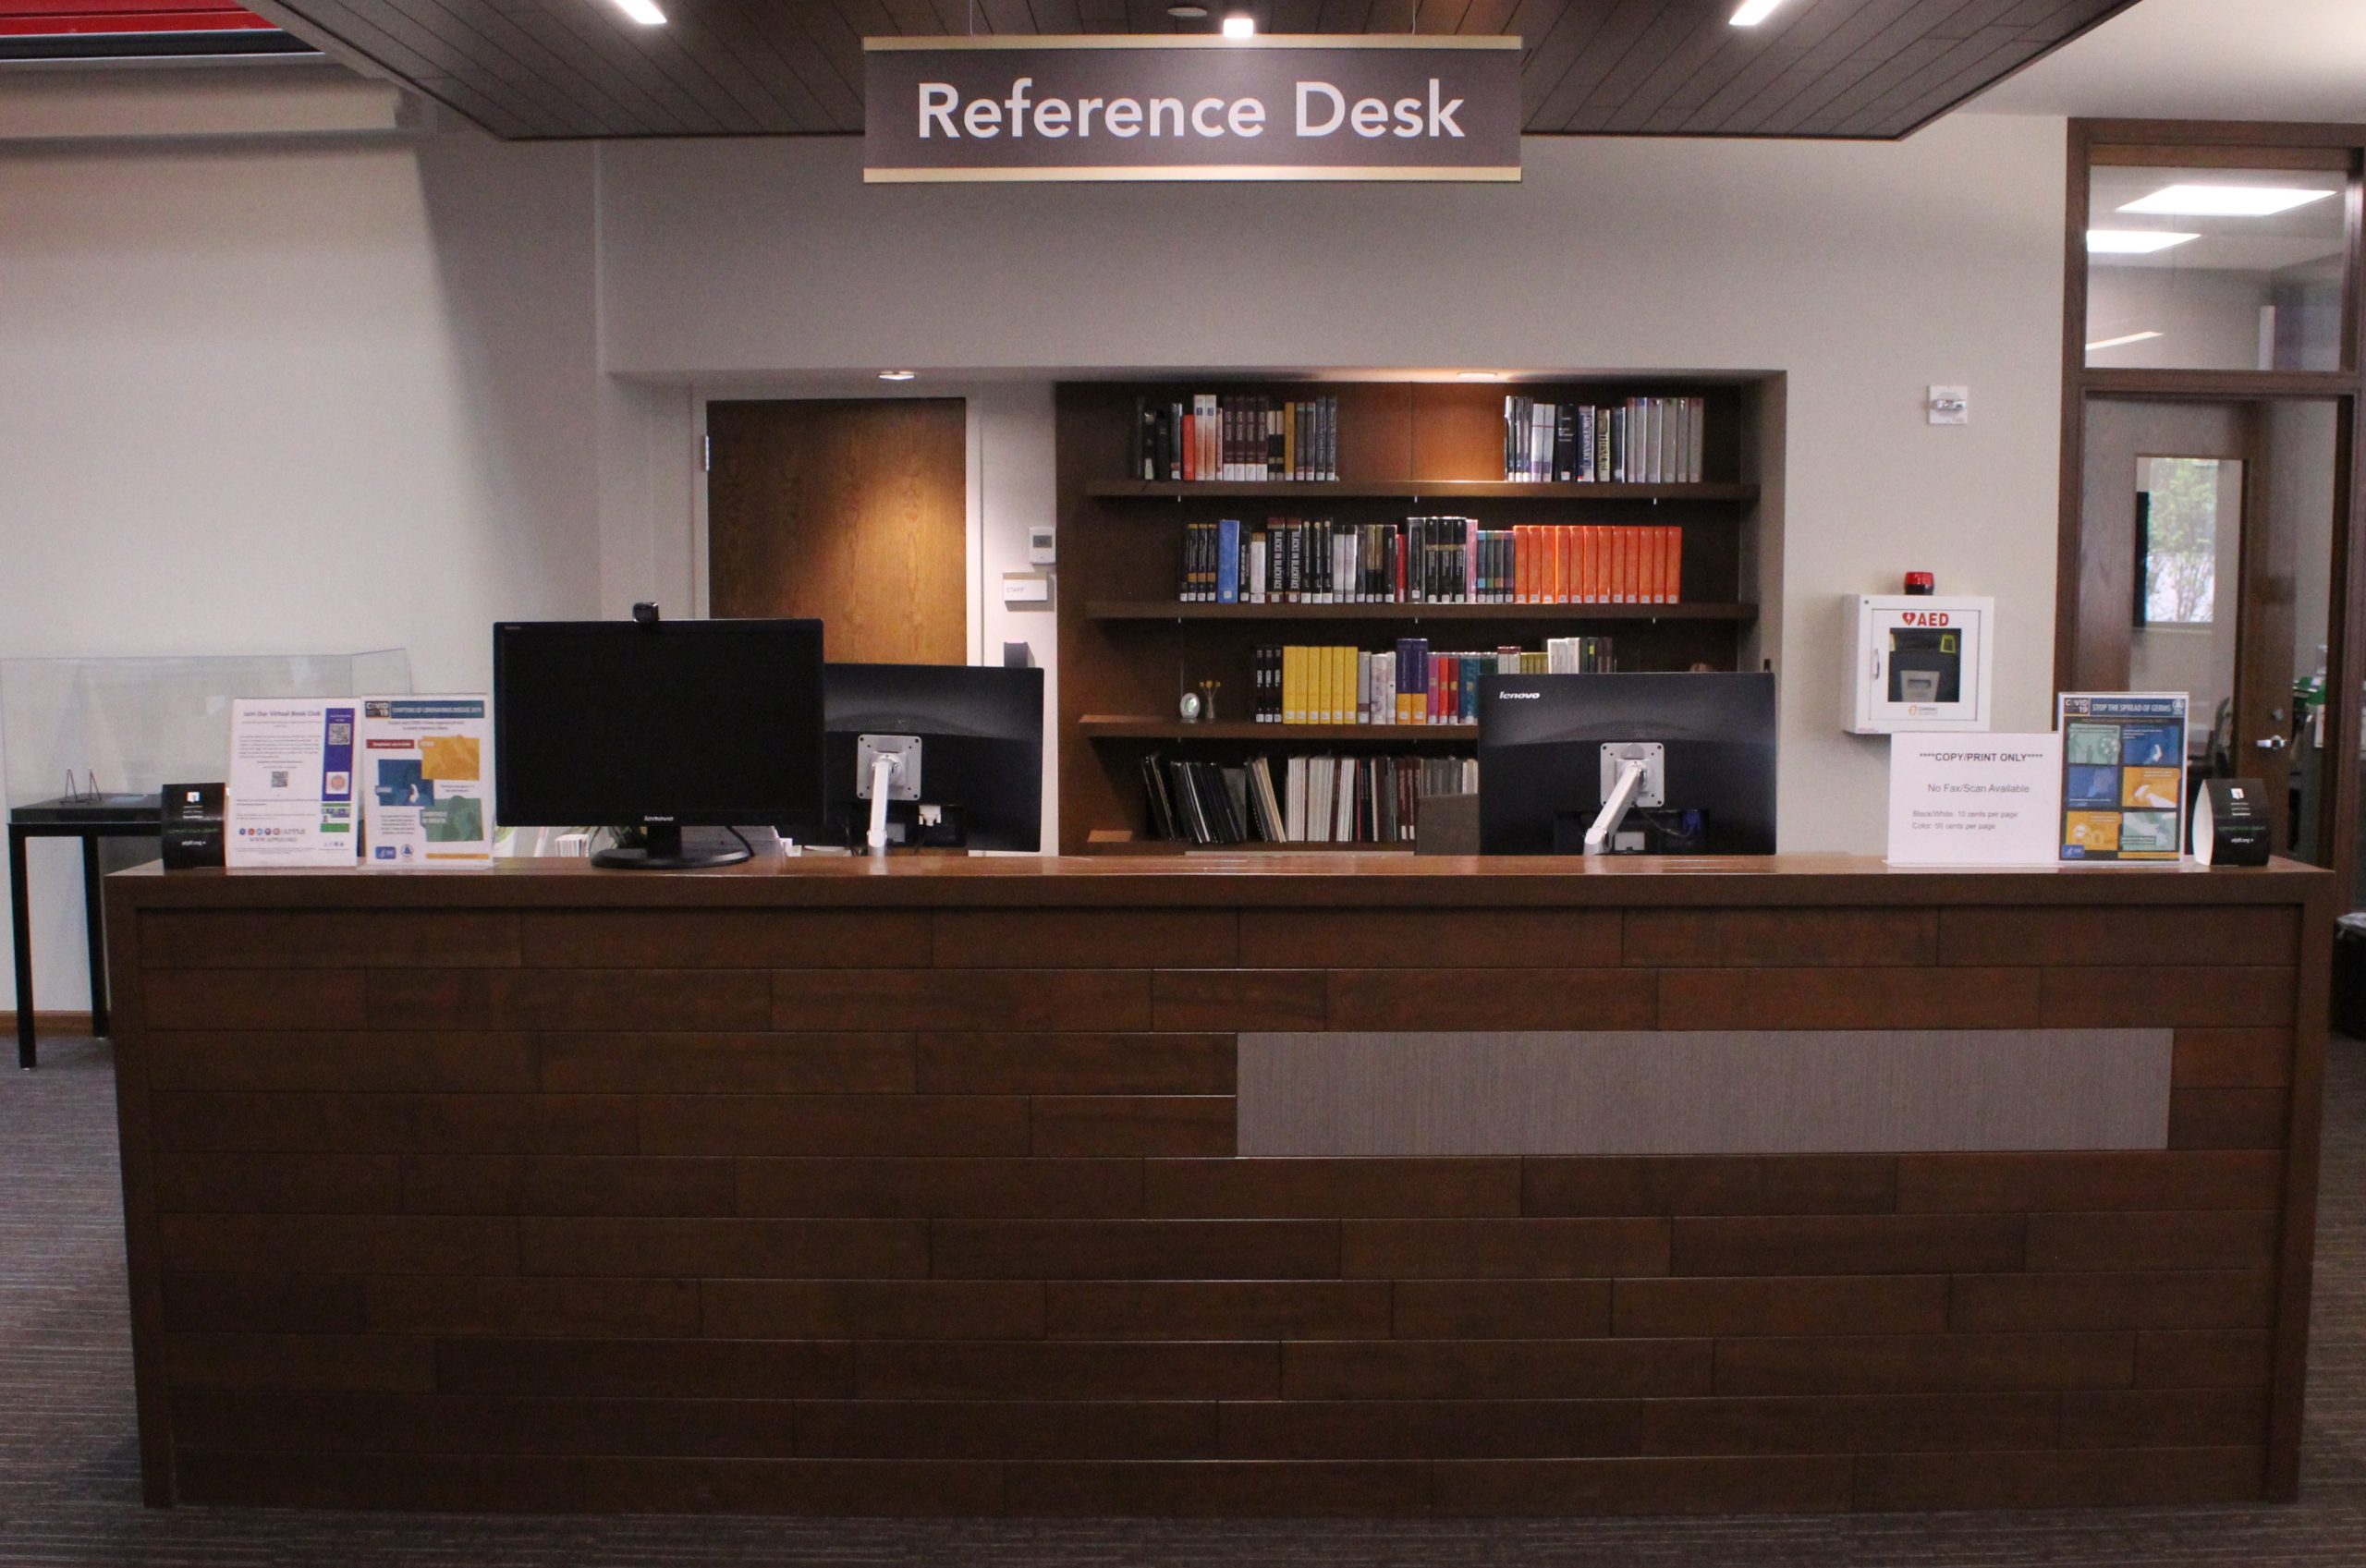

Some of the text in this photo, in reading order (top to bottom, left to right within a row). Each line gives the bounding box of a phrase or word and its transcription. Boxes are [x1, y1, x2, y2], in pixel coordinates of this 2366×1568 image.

[918, 77, 1466, 139] Reference Desk
[1274, 531, 1283, 552] BLACKS
[1291, 531, 1300, 552] BLACKS
[1273, 560, 1283, 590] BLACKFACE
[1290, 560, 1299, 590] BLACKFACE
[1917, 613, 1949, 626] AED
[1499, 691, 1541, 699] lenovo
[2092, 703, 2172, 712] STOP THE SPREAD OF GERMS
[1927, 784, 2031, 793] No Fax/Scan Available
[1987, 811, 1999, 820] per
[2000, 811, 2018, 820] page
